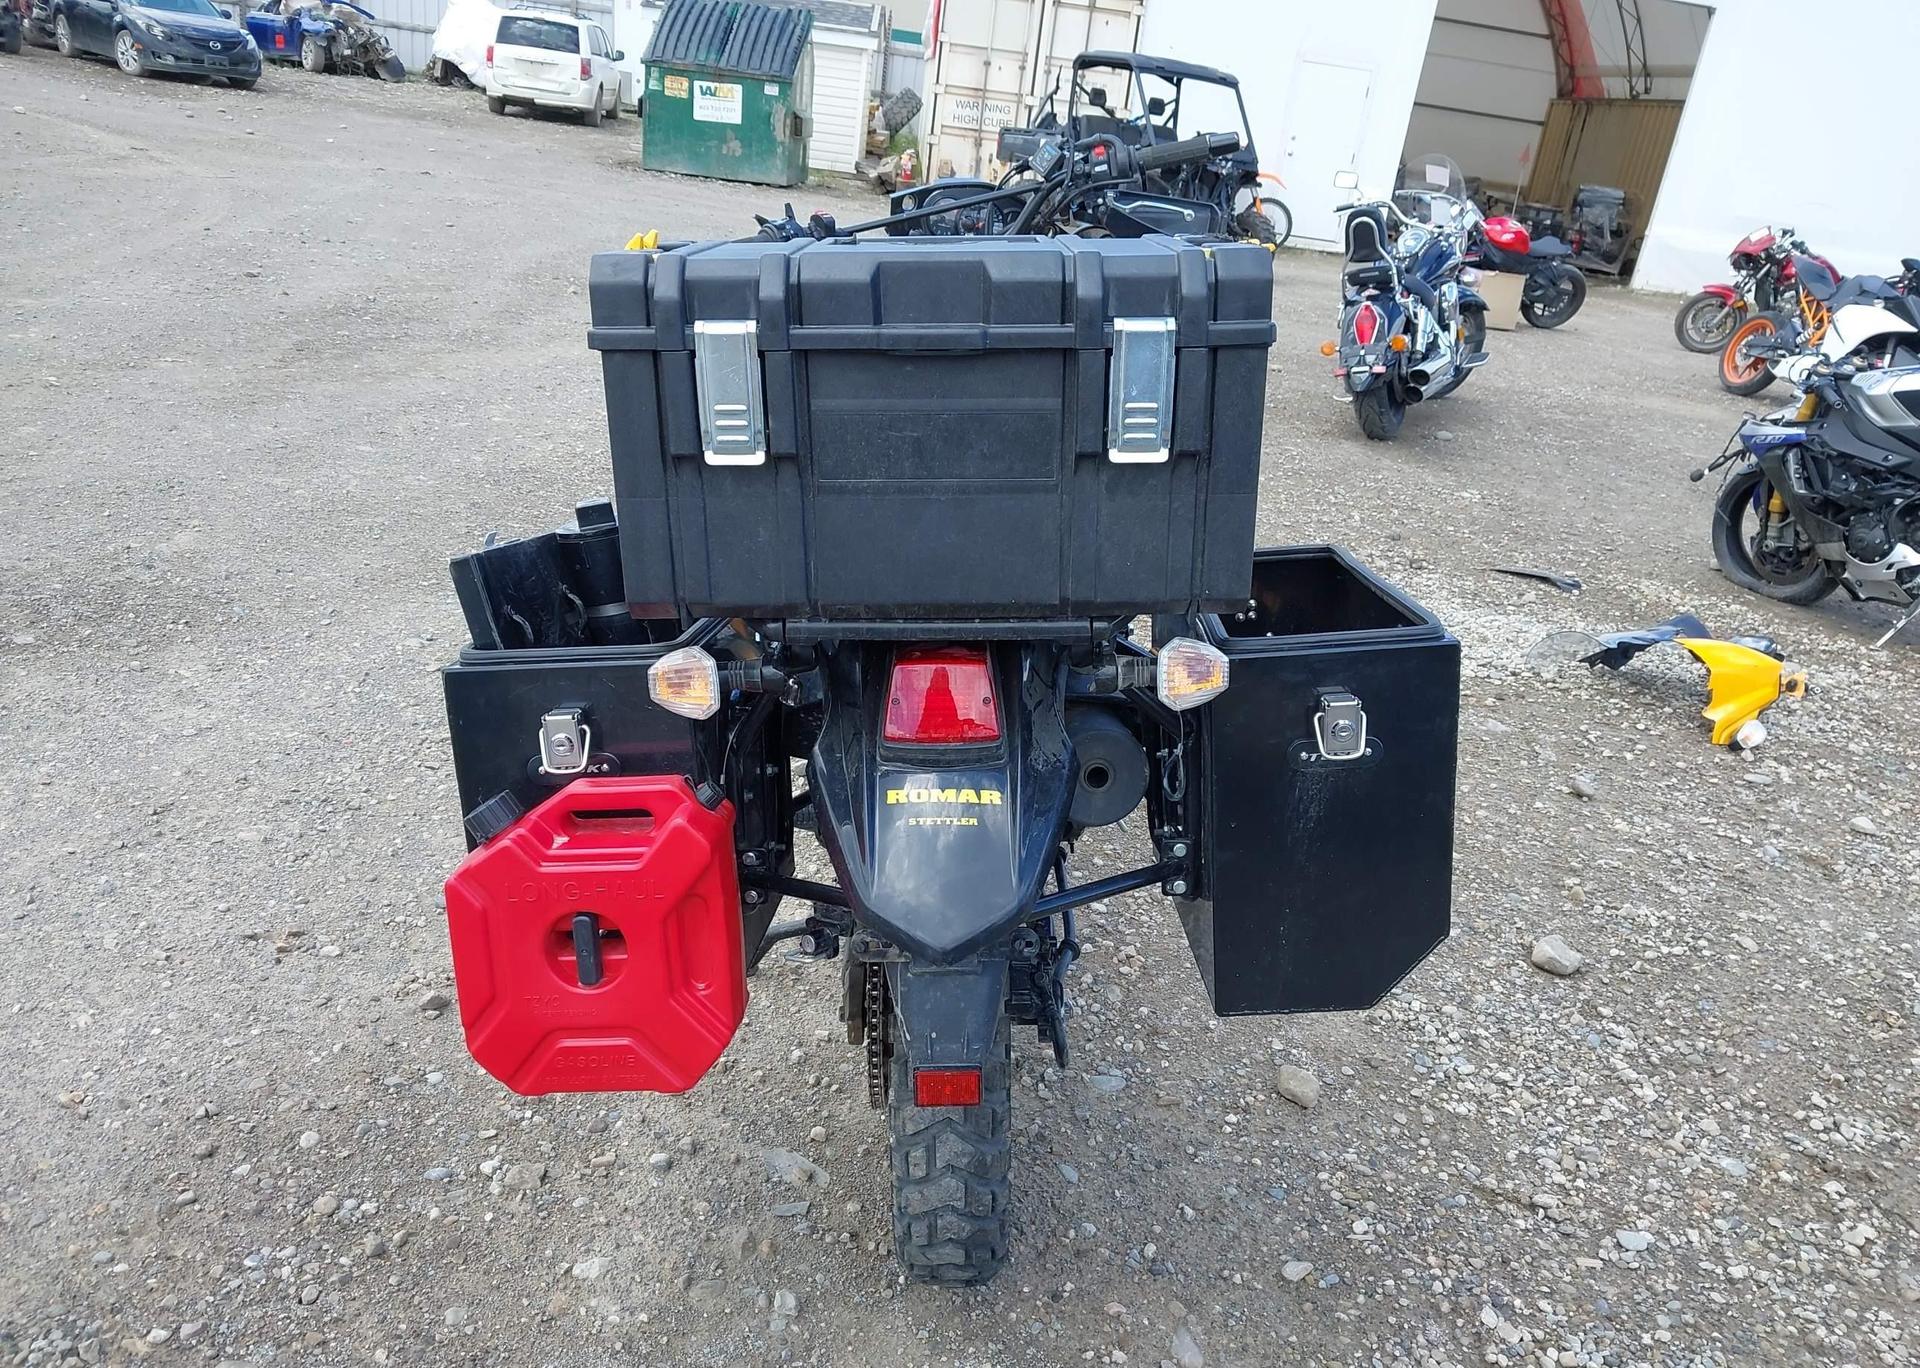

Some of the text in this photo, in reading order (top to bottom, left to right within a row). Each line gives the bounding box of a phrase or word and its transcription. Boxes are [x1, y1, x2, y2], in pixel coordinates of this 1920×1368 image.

[955, 99, 1011, 115] WARNING
[952, 113, 979, 127] HIGH
[886, 788, 1003, 805] ROMAR
[908, 817, 979, 827] STETTLER
[554, 1055, 637, 1068] GASOLINE
